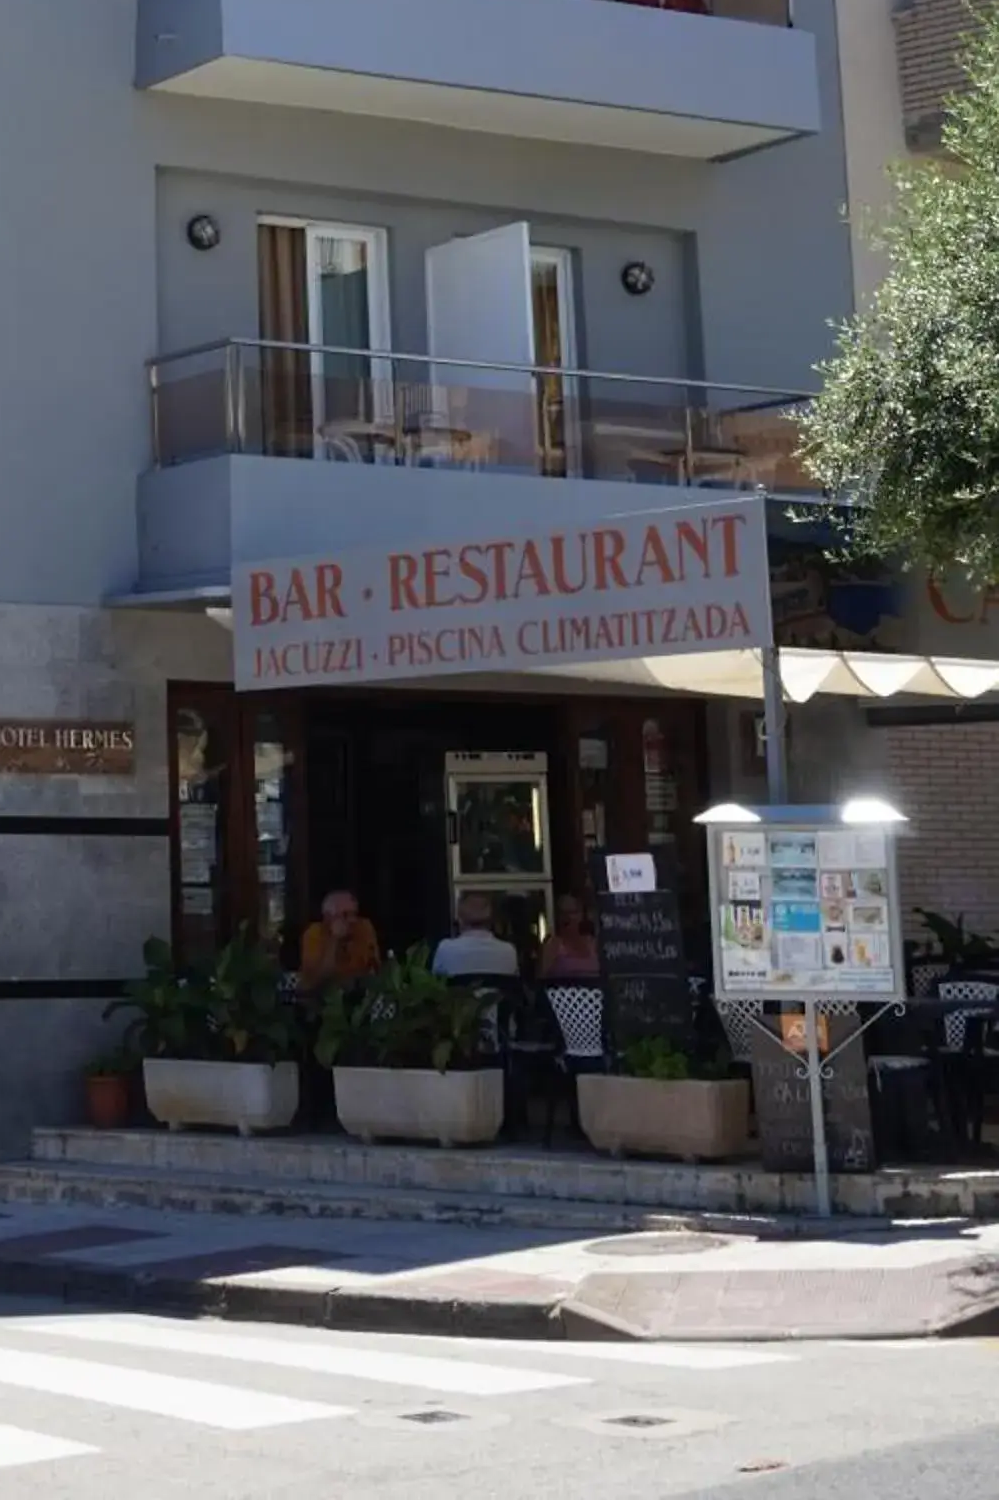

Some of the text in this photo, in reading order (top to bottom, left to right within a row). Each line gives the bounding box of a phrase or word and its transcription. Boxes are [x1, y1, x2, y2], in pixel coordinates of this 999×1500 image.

[250, 513, 747, 627] BAR RESTAURANT
[254, 601, 751, 678] JACUZZI PISCINA CLIMATITZADA
[54, 728, 133, 750] HERMES
